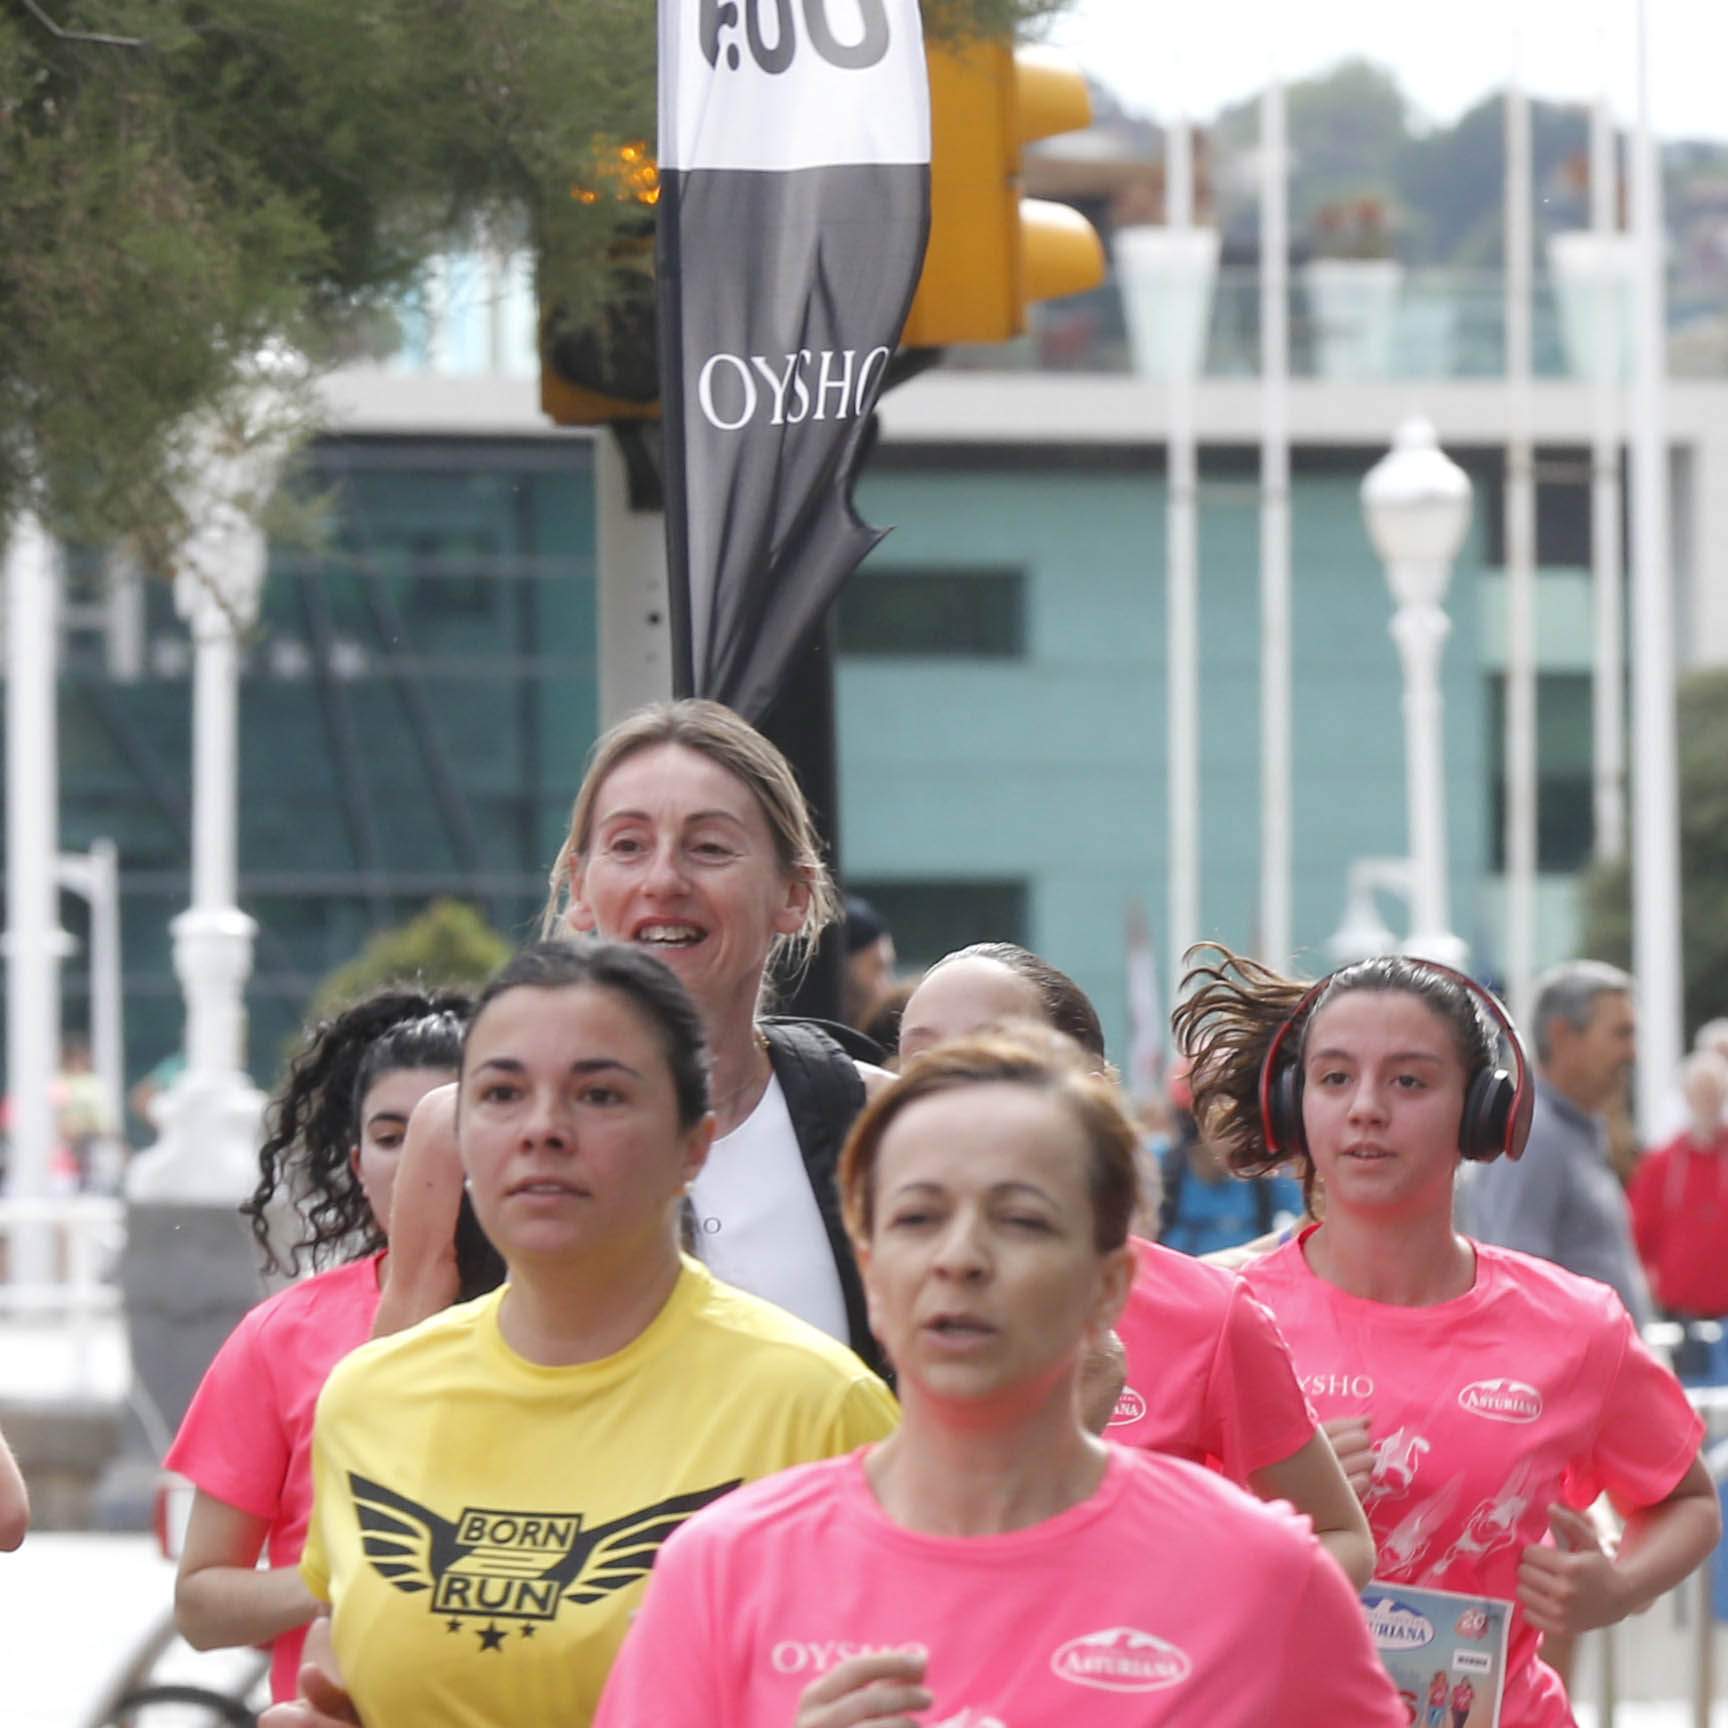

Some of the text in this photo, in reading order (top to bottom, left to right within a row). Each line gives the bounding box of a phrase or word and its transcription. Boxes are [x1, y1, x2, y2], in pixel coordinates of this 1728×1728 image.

[1467, 1391, 1538, 1415] ASTURIANA
[463, 1517, 572, 1547] BORN
[442, 1576, 552, 1612] RUN
[1066, 1651, 1181, 1678] ASTURIANA
